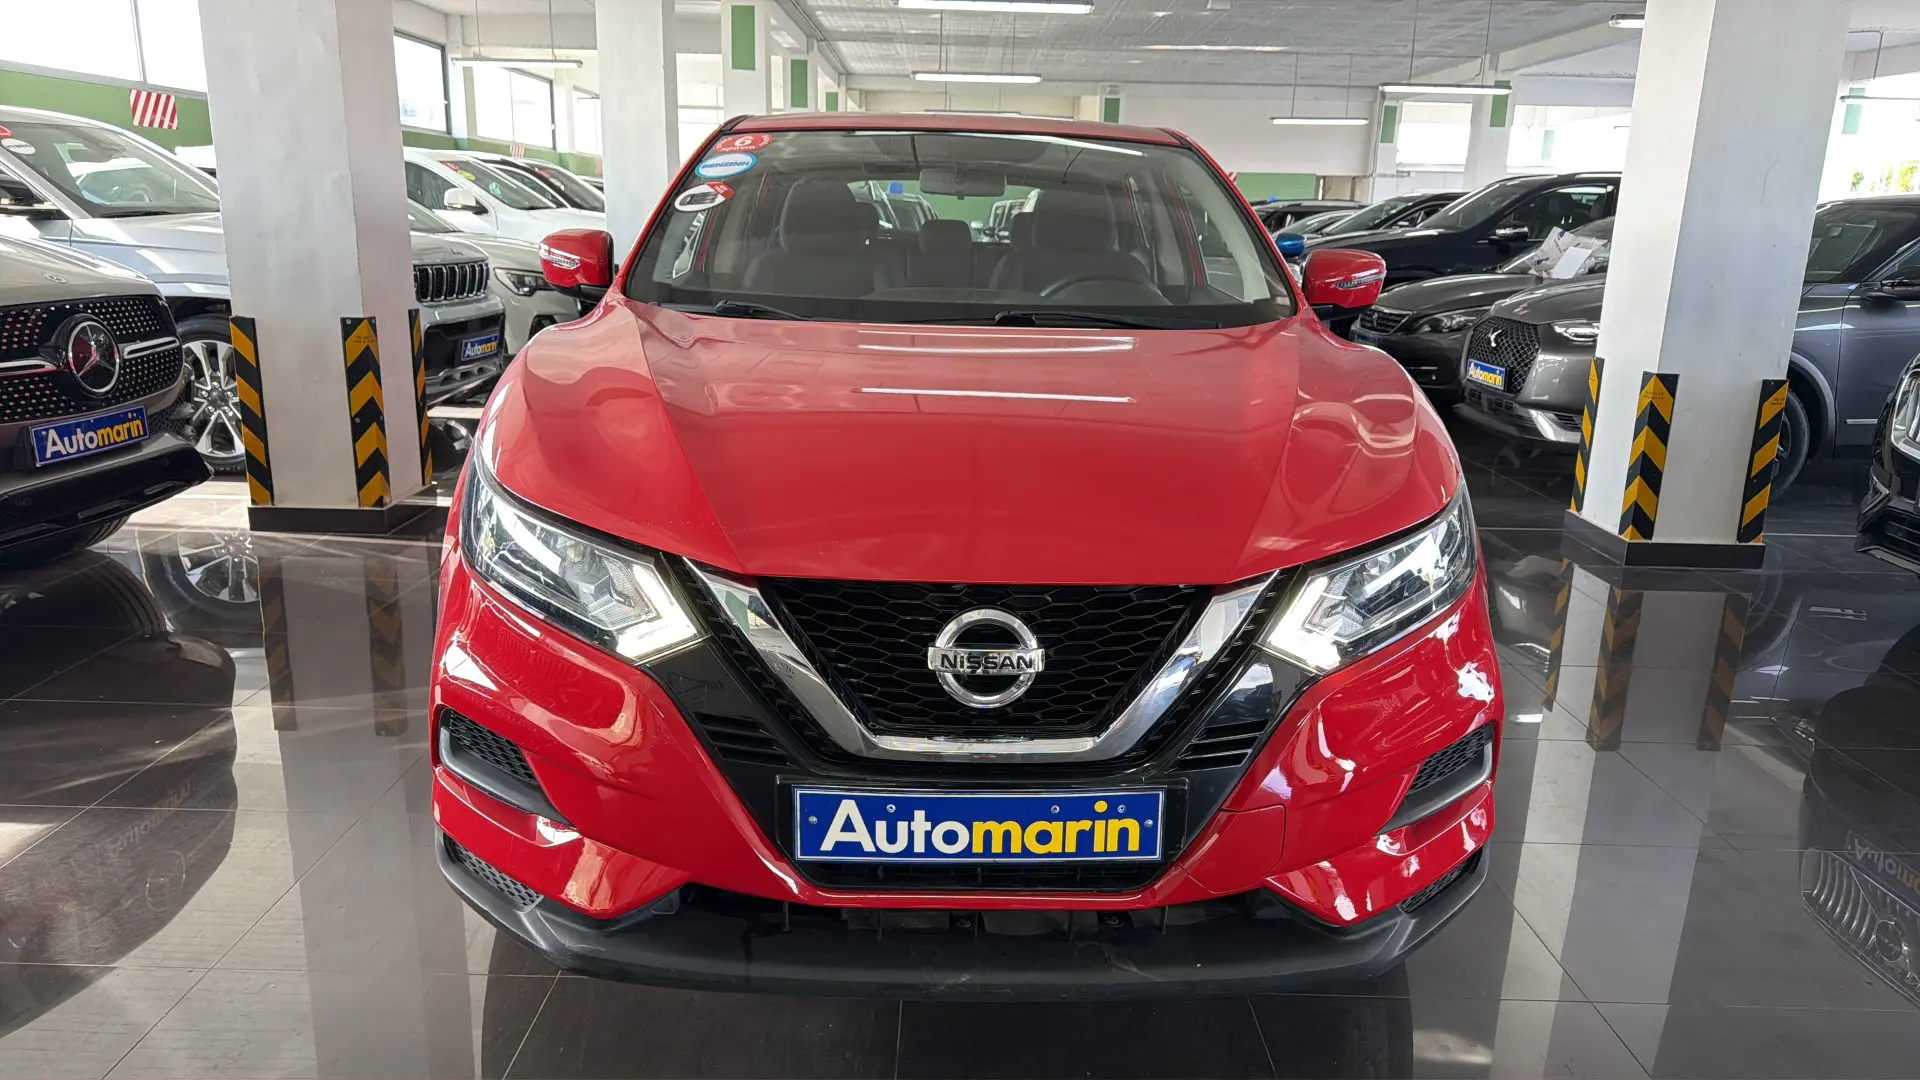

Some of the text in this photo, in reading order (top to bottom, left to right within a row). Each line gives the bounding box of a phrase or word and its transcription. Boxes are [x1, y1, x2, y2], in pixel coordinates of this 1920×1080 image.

[734, 135, 754, 147] 6
[1468, 361, 1503, 387] Automarin
[45, 412, 144, 458] Automarin
[940, 653, 1033, 670] NISSAN
[820, 799, 1140, 854] Automarin
